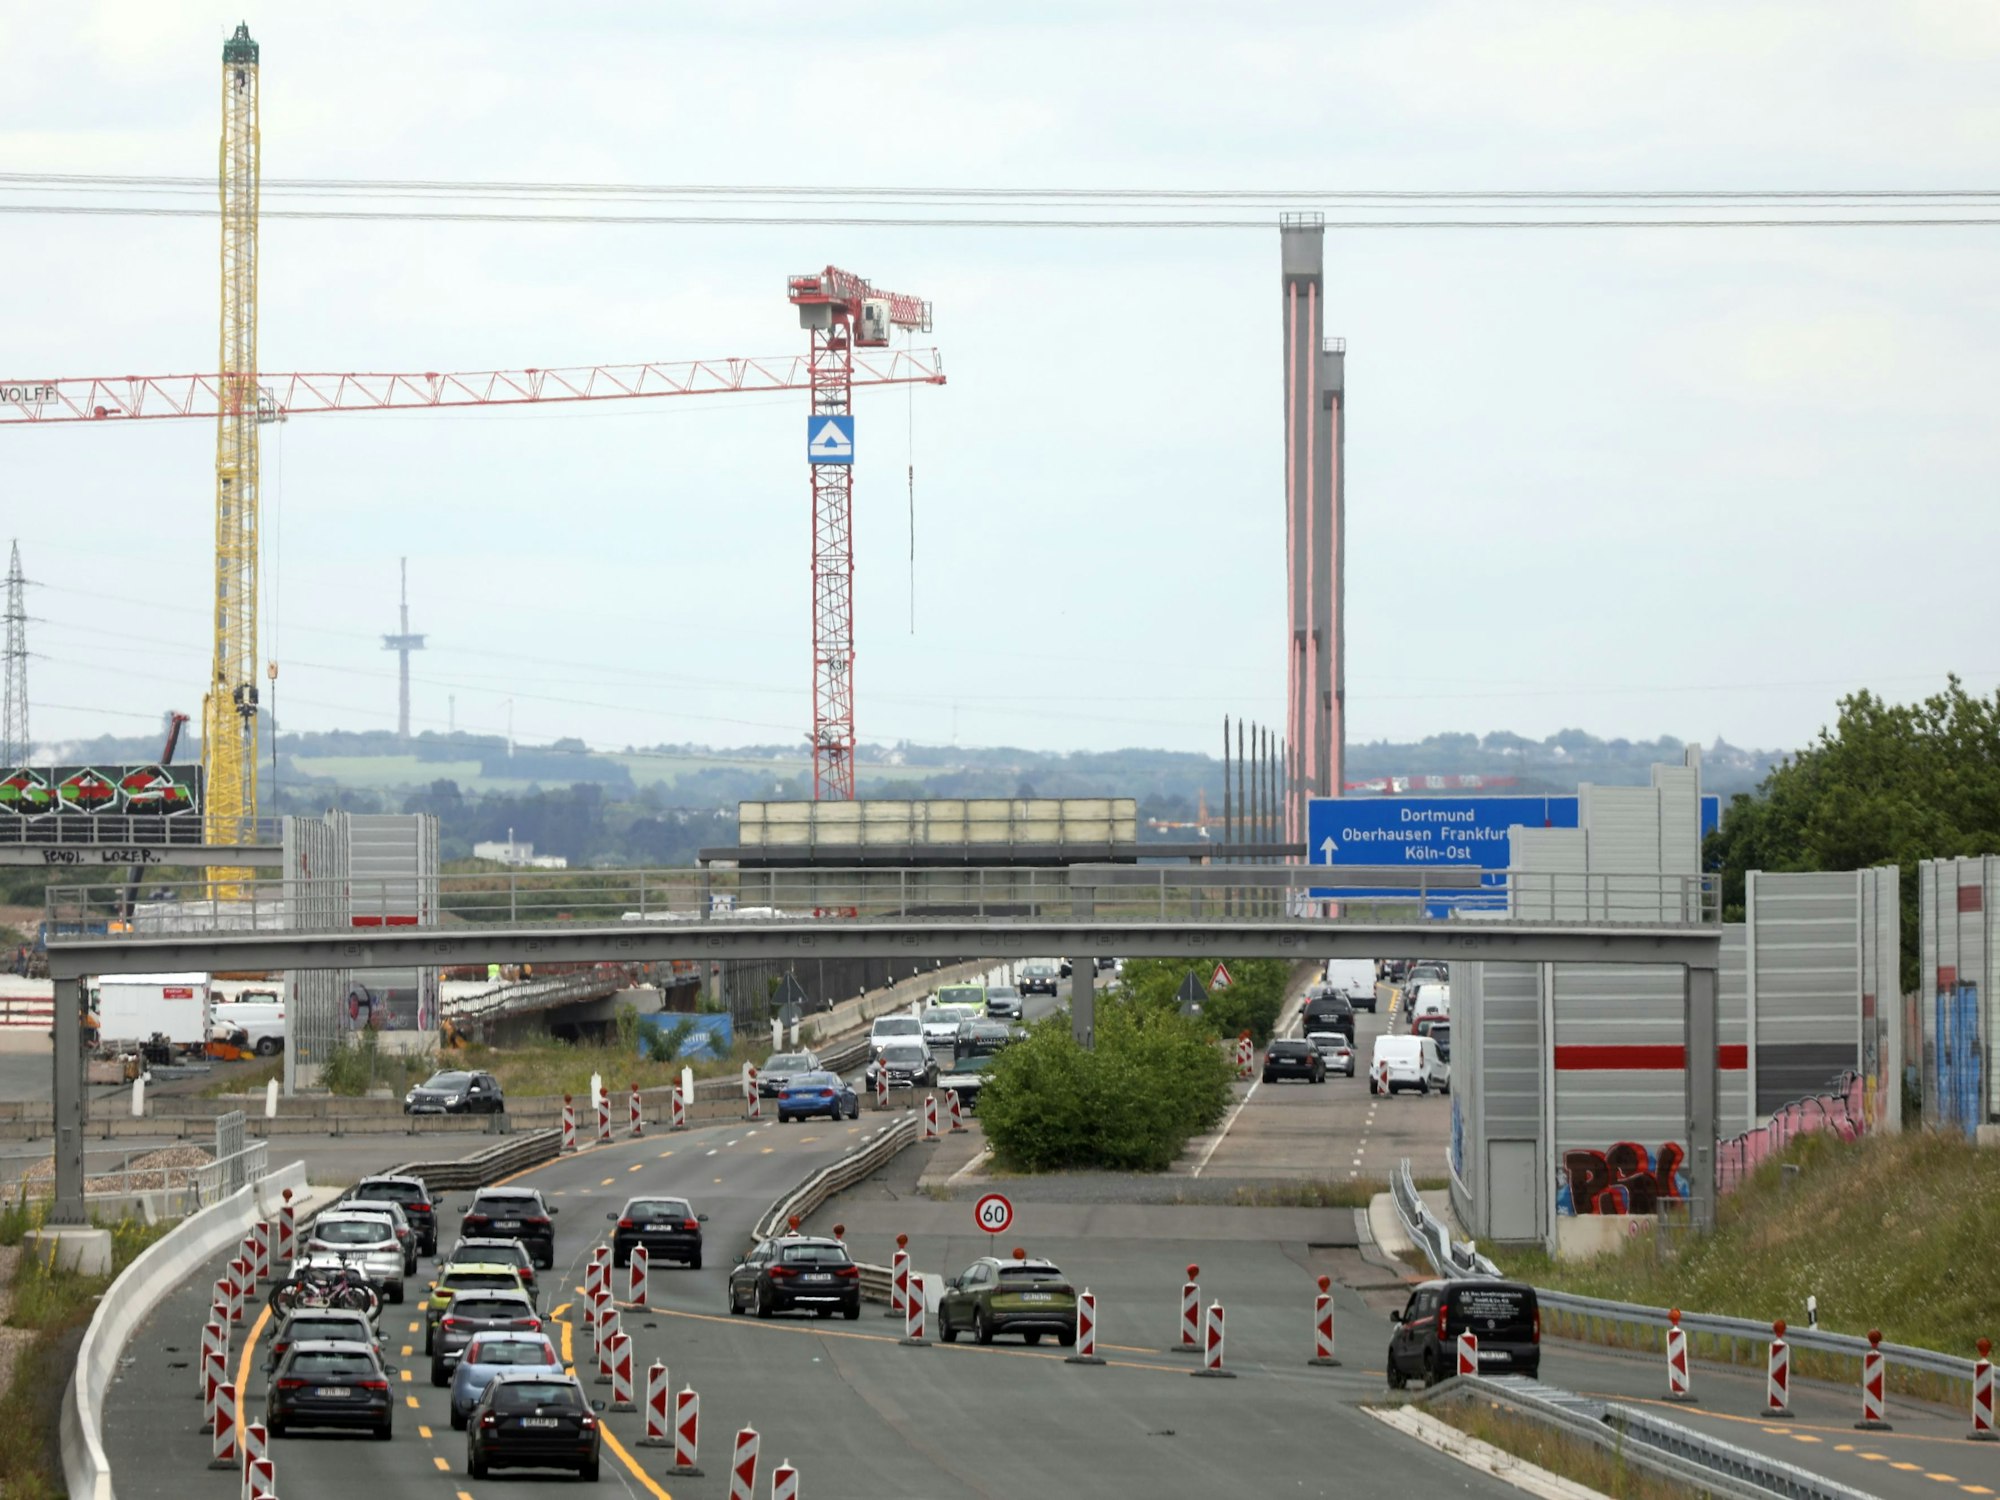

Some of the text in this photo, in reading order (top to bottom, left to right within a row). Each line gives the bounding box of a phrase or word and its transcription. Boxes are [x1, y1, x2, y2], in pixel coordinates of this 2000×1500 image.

[1401, 808, 1475, 822] Dortmund
[1342, 828, 1432, 841] Oberhausen
[1405, 845, 1472, 860] Köln-Ost
[983, 1204, 1004, 1223] 60
